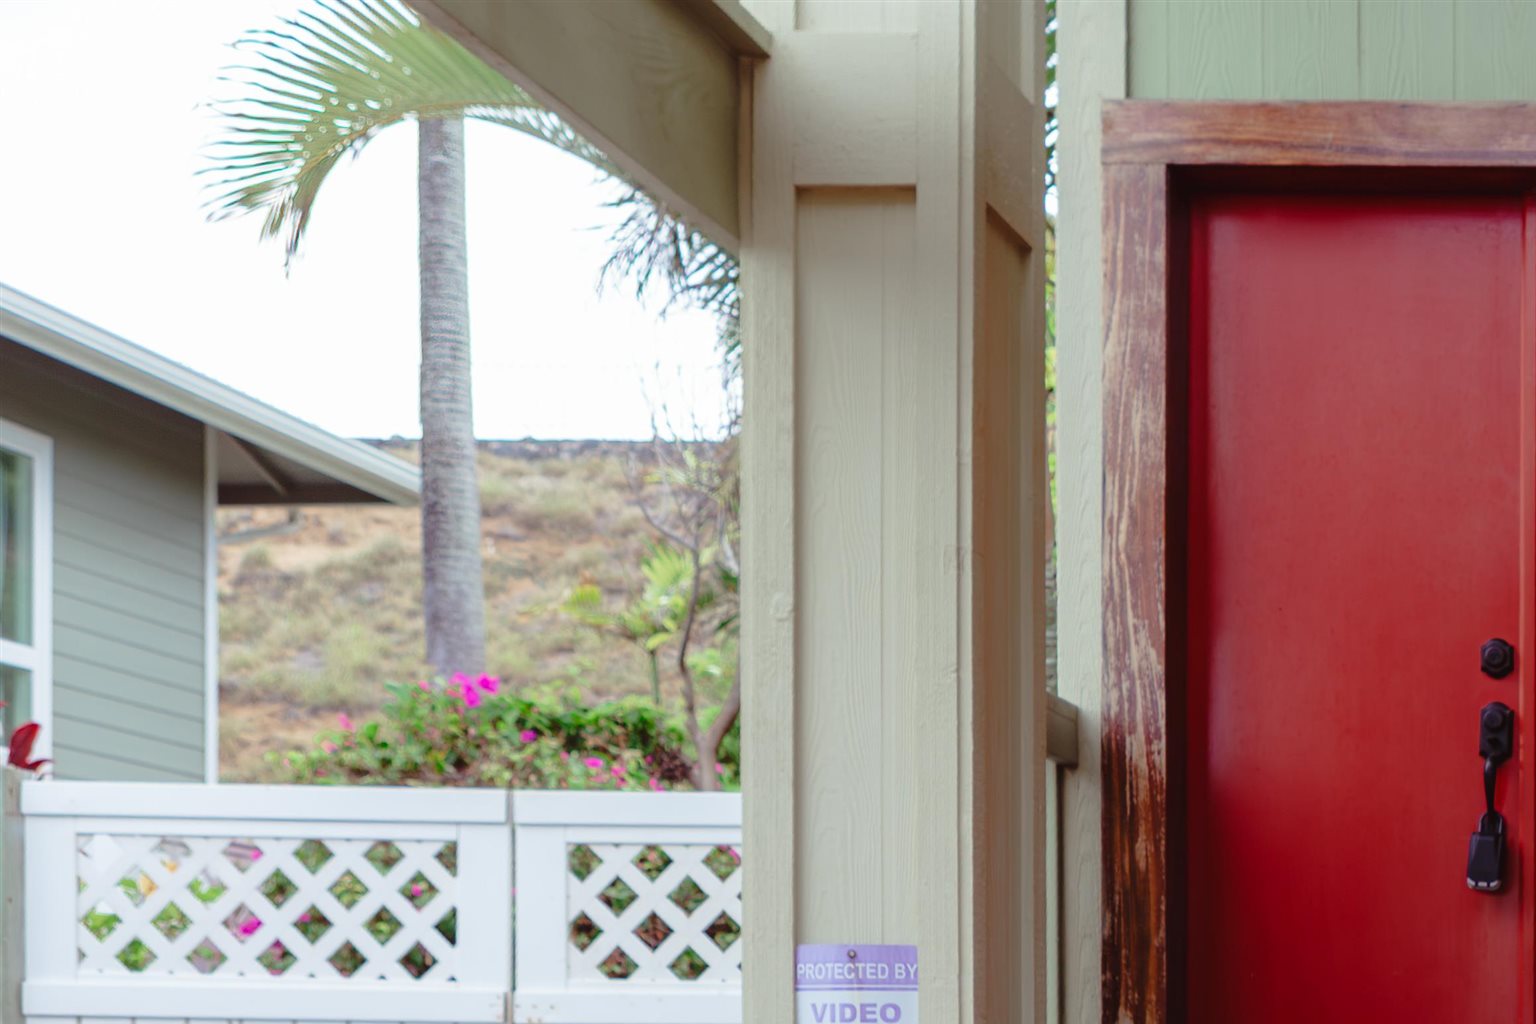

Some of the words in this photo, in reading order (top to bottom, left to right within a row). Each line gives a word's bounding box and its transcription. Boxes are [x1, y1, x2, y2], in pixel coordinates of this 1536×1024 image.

[797, 962, 889, 980] PROTECTED
[894, 962, 918, 980] BY
[811, 1002, 902, 1024] VIDEO
